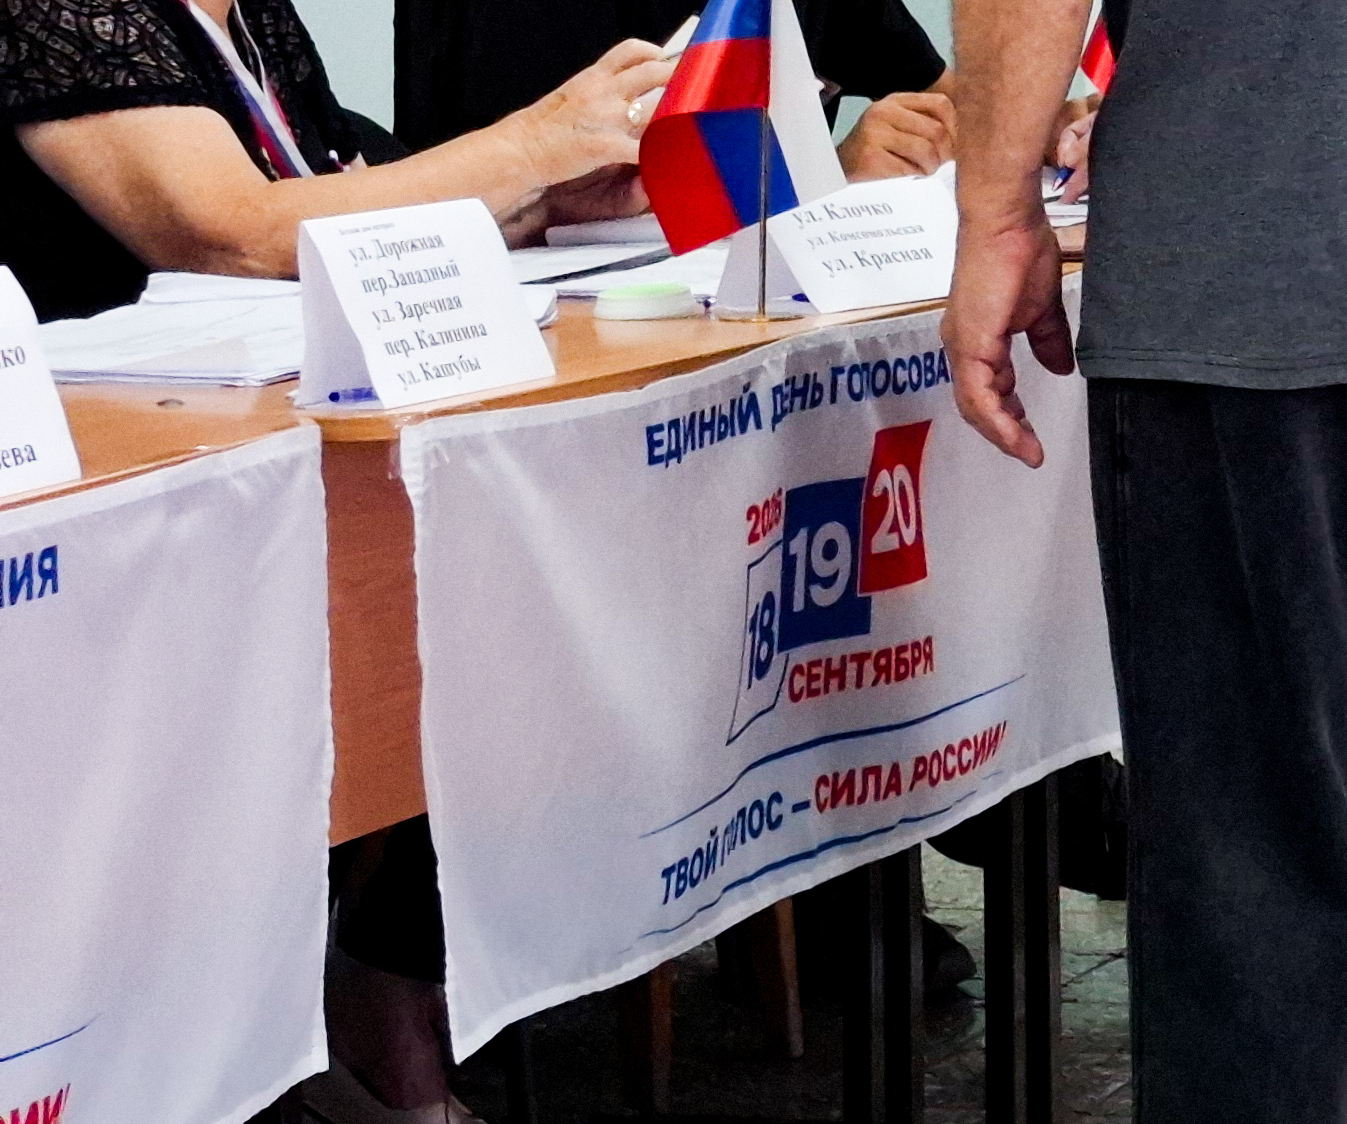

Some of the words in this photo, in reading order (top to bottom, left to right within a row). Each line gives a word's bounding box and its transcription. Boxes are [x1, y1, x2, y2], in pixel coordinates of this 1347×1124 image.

[793, 210, 823, 230] ул.
[823, 203, 894, 221] Клочко
[349, 247, 372, 268] ул.
[372, 234, 446, 261] Дорожная
[822, 258, 854, 278] ул.
[853, 247, 935, 271] Красная
[395, 295, 463, 323] Заречная
[384, 339, 415, 358] пер.
[414, 323, 488, 350] Калинина
[419, 354, 482, 381] Кашубы
[646, 382, 763, 468] ЕДИНЫЙ
[748, 591, 776, 690] 18
[789, 521, 852, 613] 19
[871, 463, 917, 555] 20
[788, 635, 935, 704] СЕНТЯБРЯ
[661, 825, 720, 906] ТВОЙ
[815, 762, 903, 815] СИЛА
